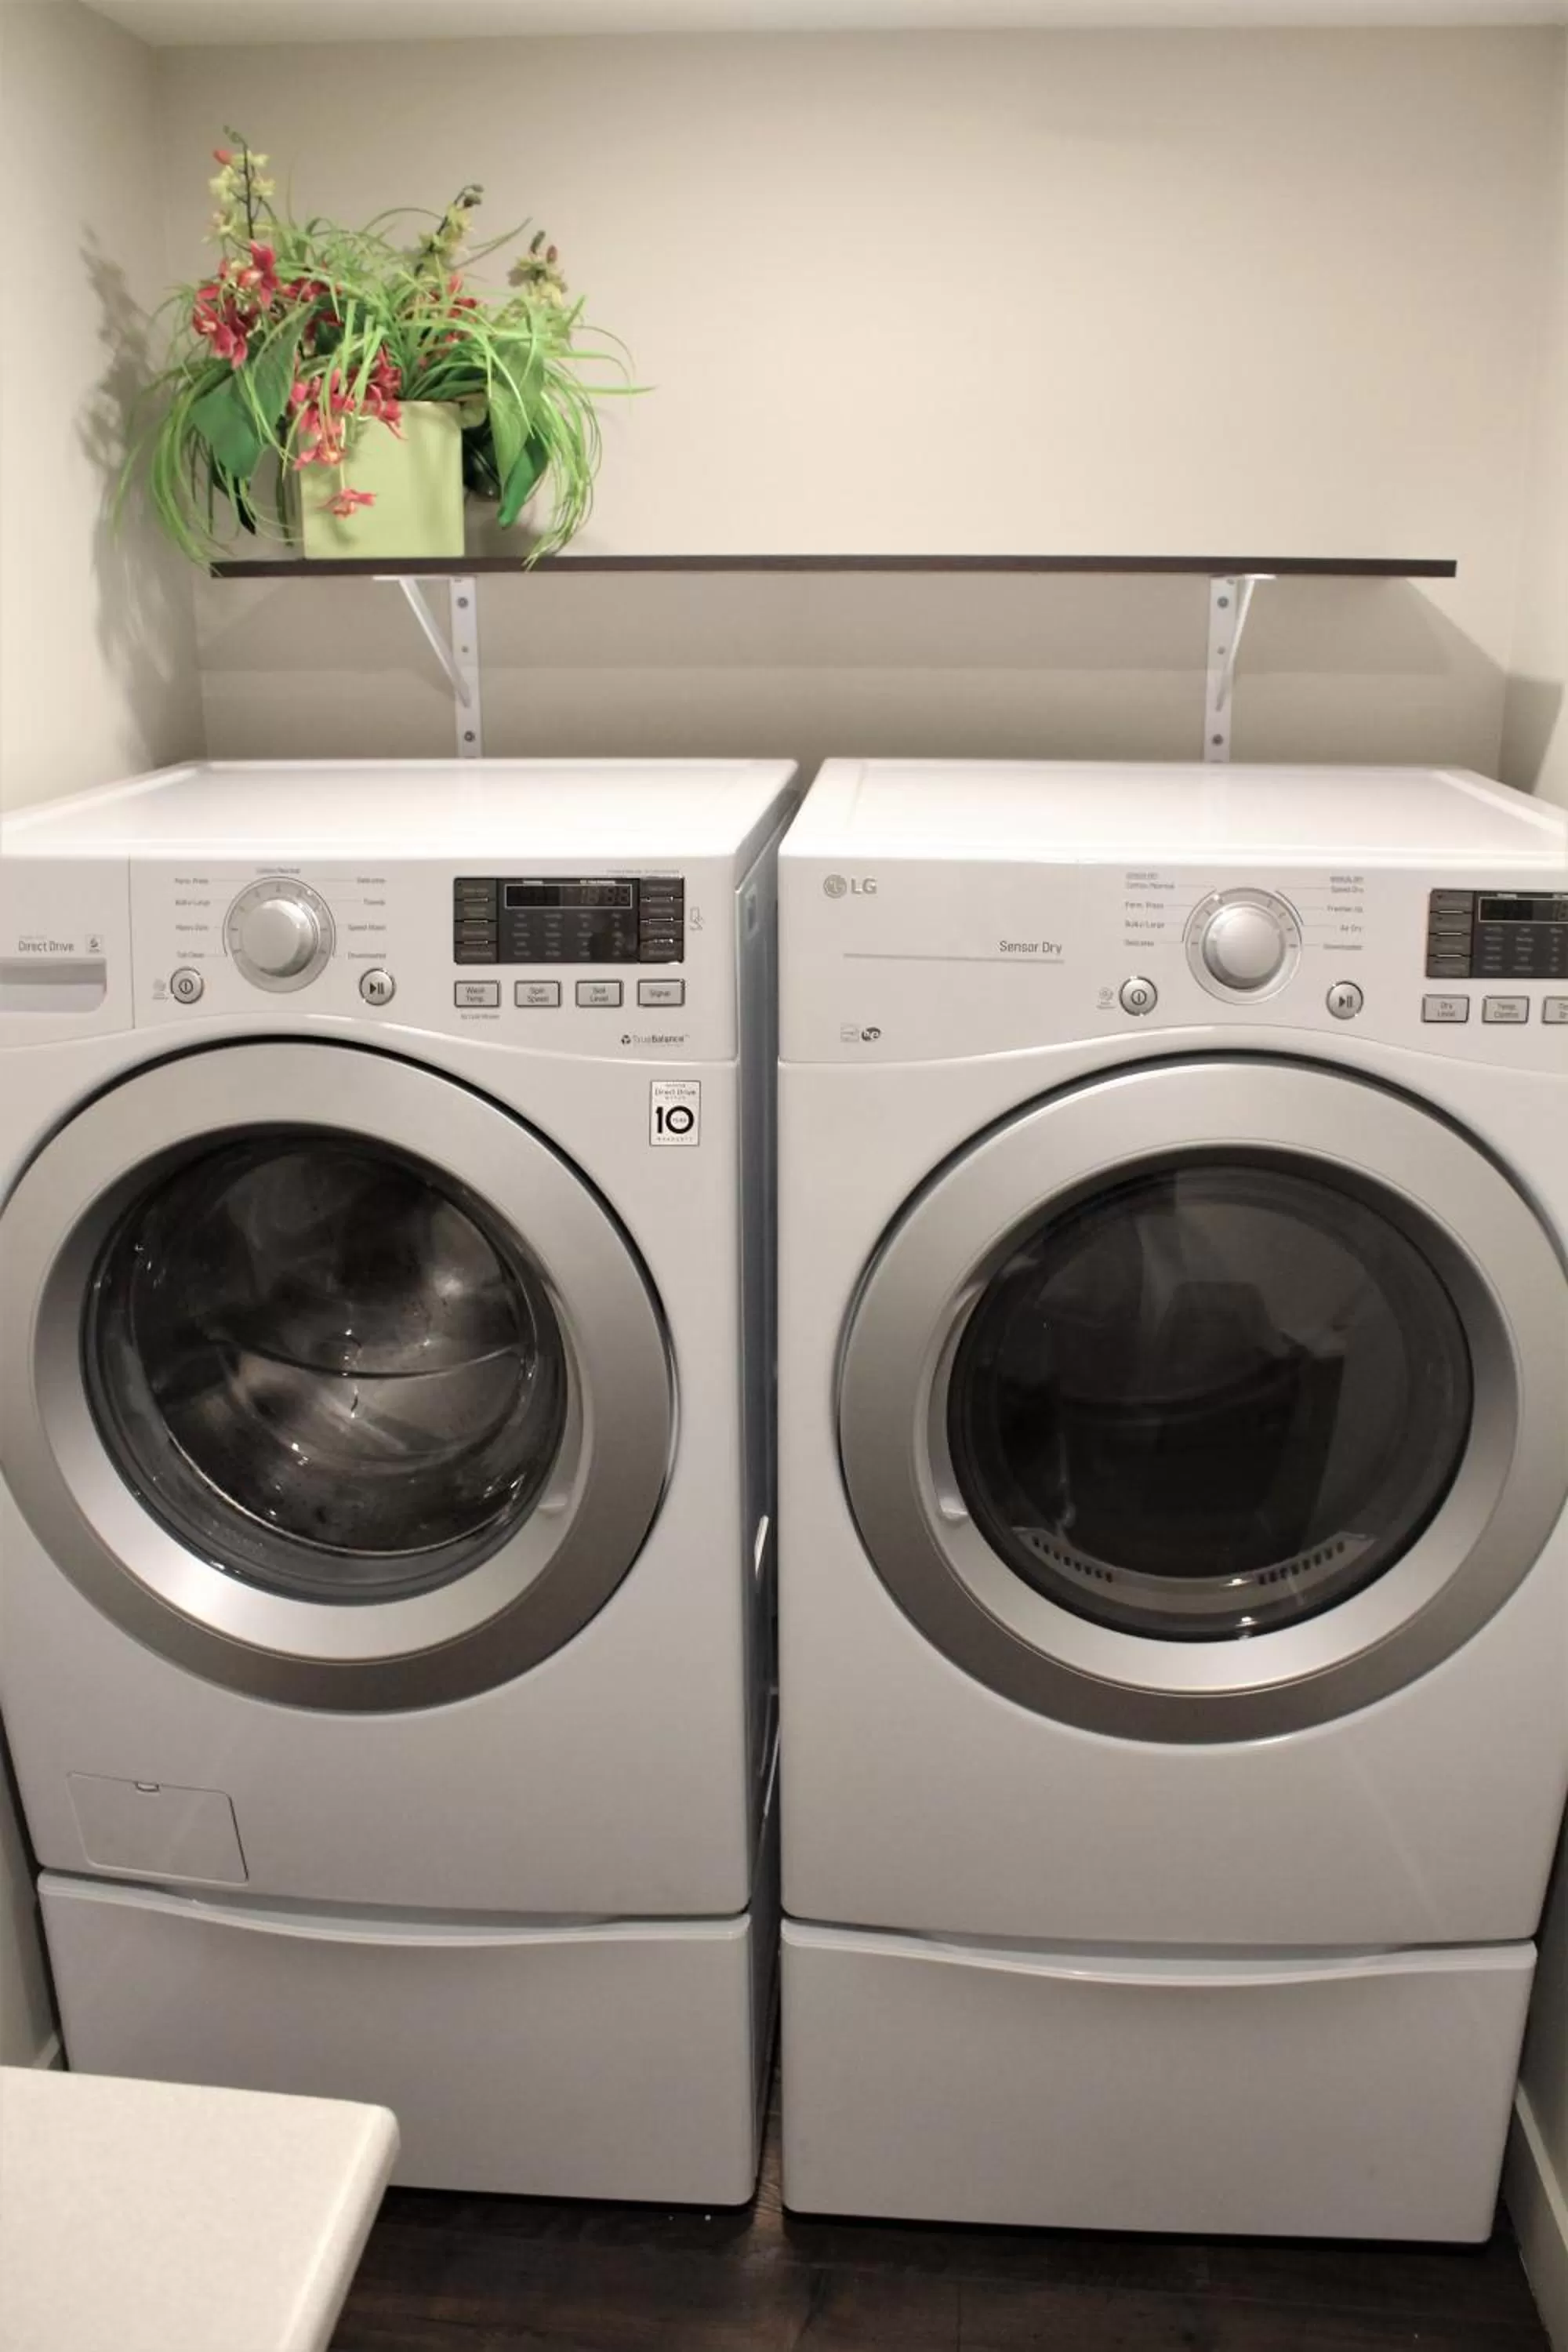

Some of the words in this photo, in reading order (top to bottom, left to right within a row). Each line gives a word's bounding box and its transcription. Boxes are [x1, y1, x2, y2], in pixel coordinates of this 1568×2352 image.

[851, 877, 877, 895] LG
[18, 940, 47, 952] Direct
[49, 940, 74, 952] Drive
[1000, 940, 1039, 953] Sensor
[1042, 941, 1062, 956] Dry
[654, 1105, 695, 1134] 10
